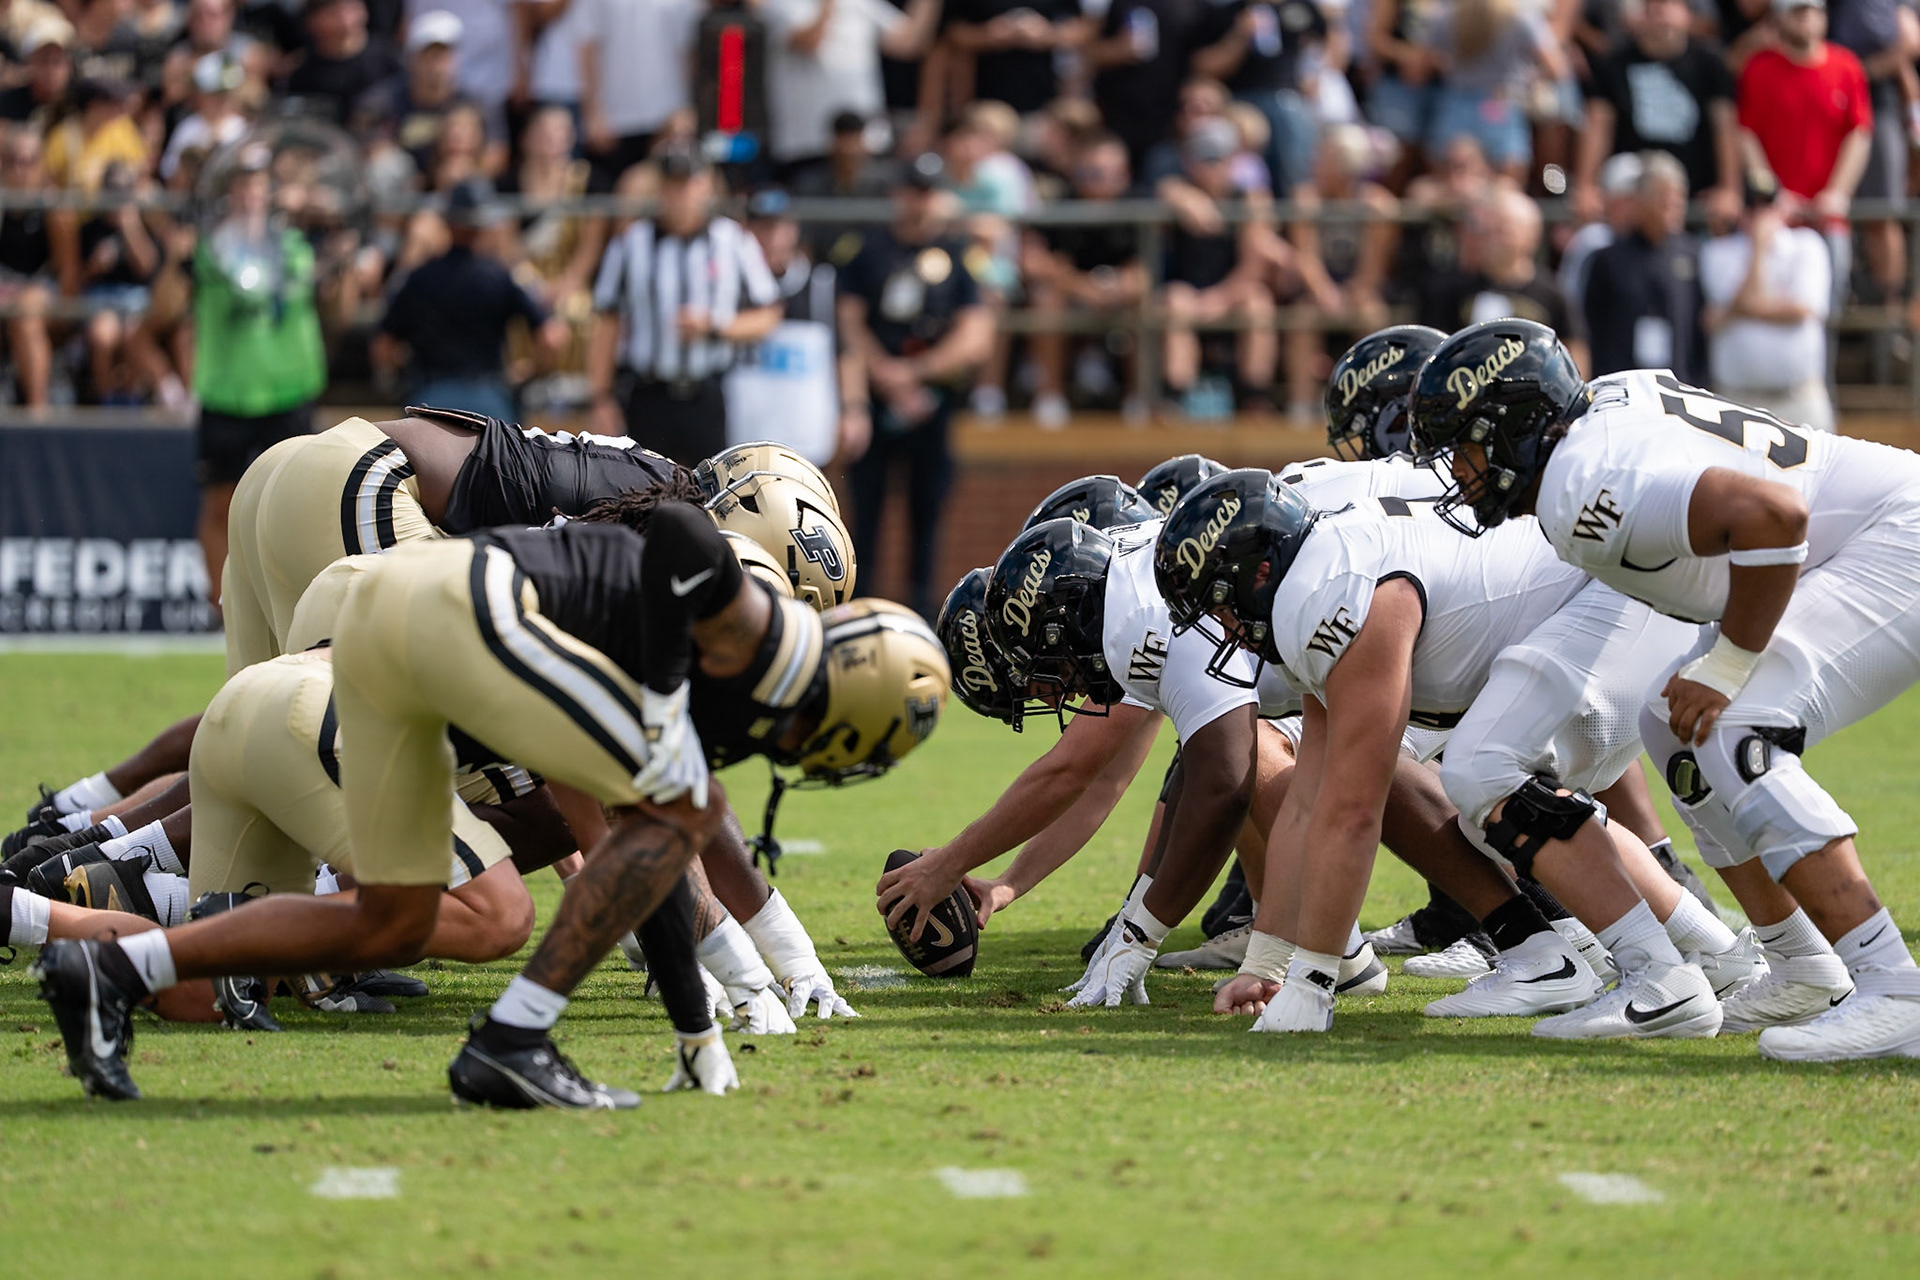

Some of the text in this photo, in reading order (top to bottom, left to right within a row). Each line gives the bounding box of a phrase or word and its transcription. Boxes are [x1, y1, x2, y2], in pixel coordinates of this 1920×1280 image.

[1338, 347, 1405, 407] Deacs
[1446, 338, 1525, 410] Deacs
[1177, 497, 1241, 580] Deacs
[1572, 489, 1624, 543] WF
[788, 525, 845, 582] P
[0, 599, 143, 633] CREDIT
[1002, 549, 1052, 637] Deacs
[962, 609, 998, 693] Deacs
[1127, 630, 1168, 682] WF
[1306, 606, 1360, 659] WF
